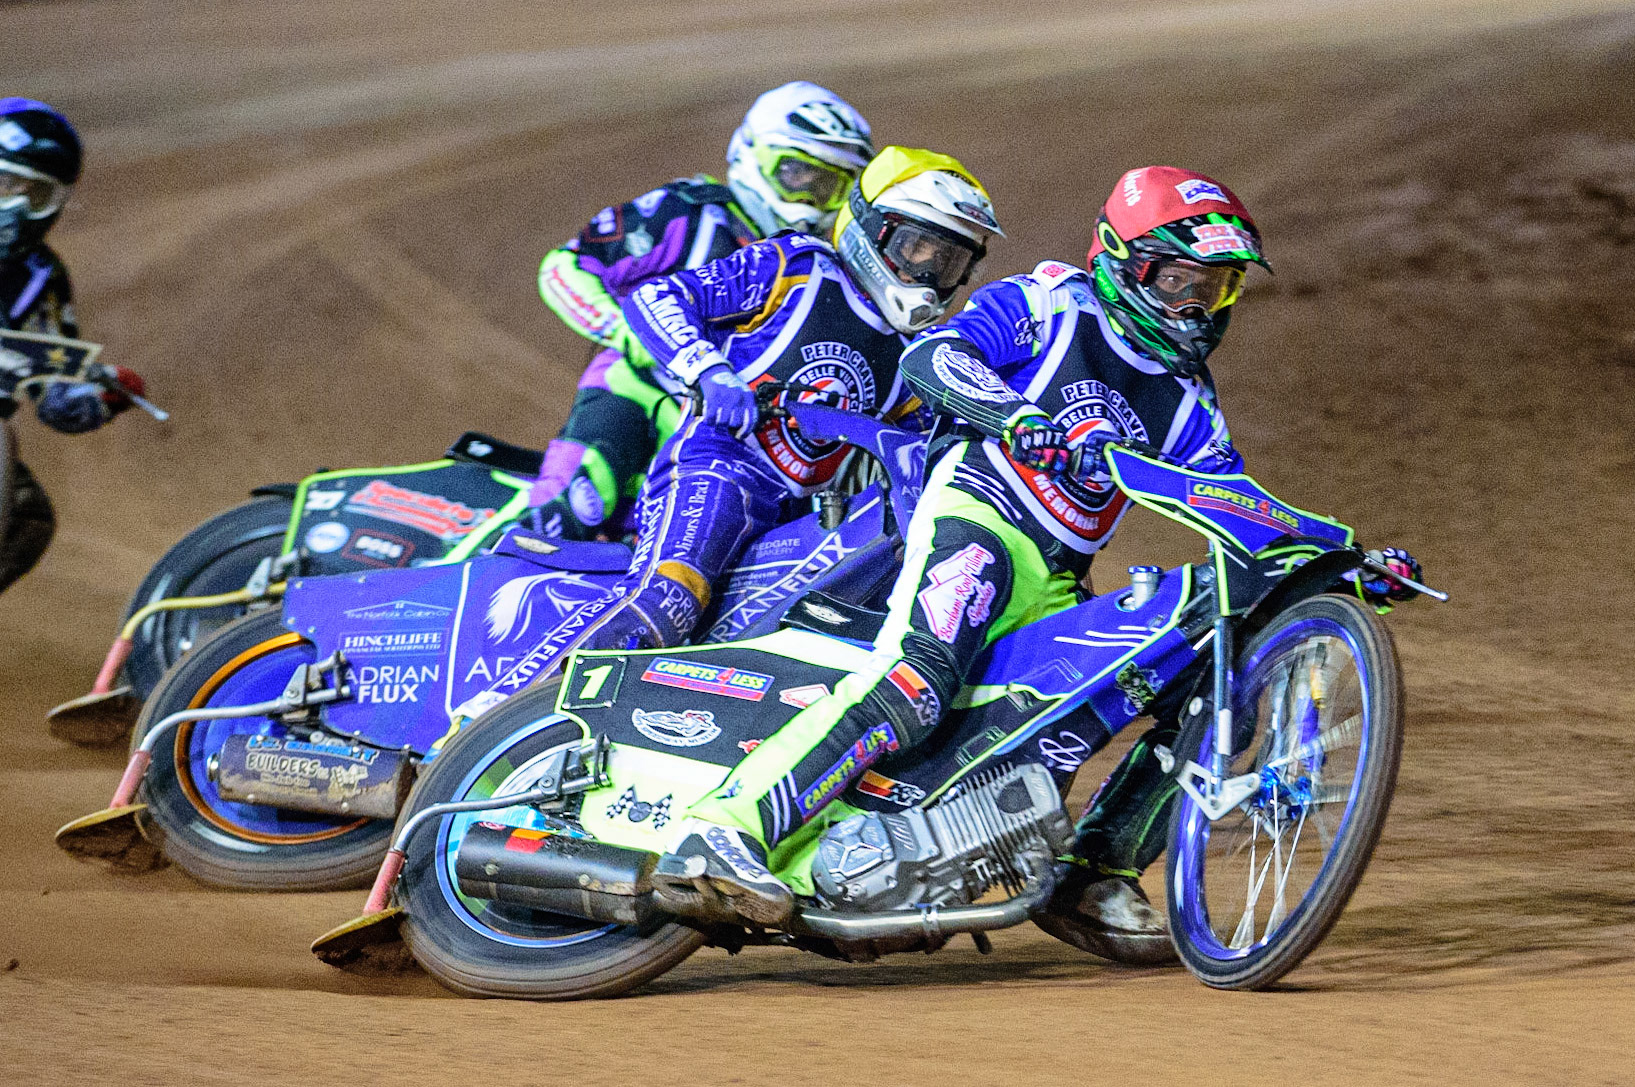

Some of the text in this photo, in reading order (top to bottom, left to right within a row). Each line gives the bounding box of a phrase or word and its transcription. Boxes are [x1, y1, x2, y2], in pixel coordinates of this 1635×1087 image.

[801, 341, 851, 363] PETER
[799, 365, 836, 385] BELLE
[1060, 405, 1102, 429] BELLE
[1193, 483, 1256, 509] CARPETS
[1257, 500, 1271, 517] 4
[1271, 507, 1299, 528] LESS
[785, 532, 858, 592] FLUX
[344, 632, 442, 648] HINCHLIFFE
[502, 643, 560, 690] FLUX
[654, 660, 720, 681] CARPETS
[717, 667, 736, 685] 4
[729, 673, 767, 690] LESS
[358, 683, 419, 704] FLUX
[578, 664, 614, 700] 1
[246, 751, 320, 779] BUILDERS
